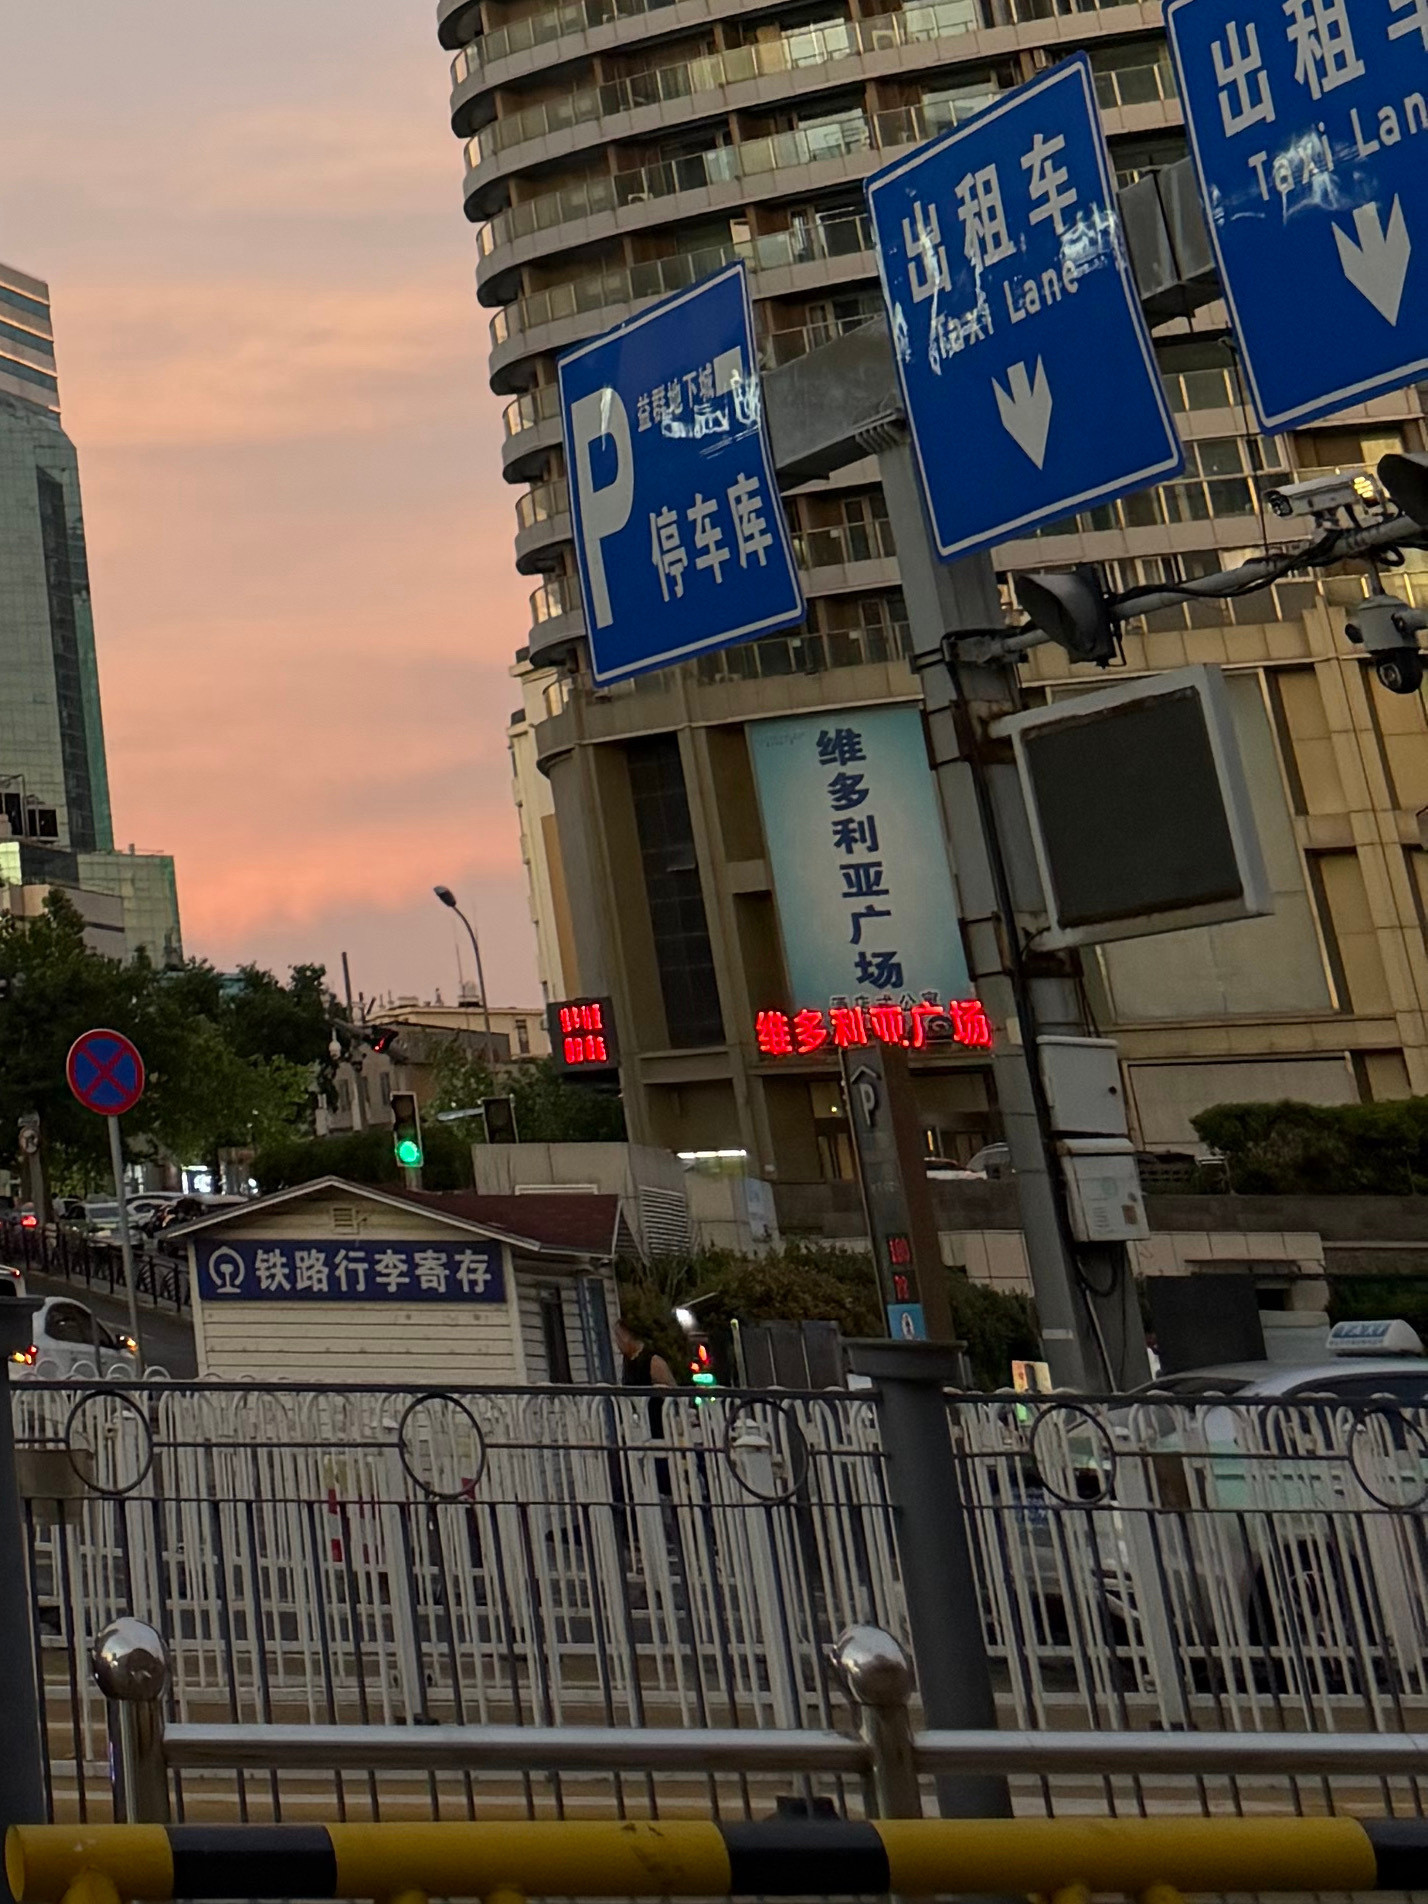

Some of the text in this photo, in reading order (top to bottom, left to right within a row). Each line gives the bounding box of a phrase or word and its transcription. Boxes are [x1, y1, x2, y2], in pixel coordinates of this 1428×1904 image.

[1249, 122, 1334, 201] Taxi
[902, 133, 1078, 304] 出租车
[1003, 259, 1080, 325] Lane
[571, 387, 635, 630] P
[649, 472, 773, 603] 停车库
[815, 727, 904, 991] 维多利亚广场
[756, 1000, 992, 1055] 维多利亚广场
[255, 1248, 493, 1294] 铁路行李寄存
